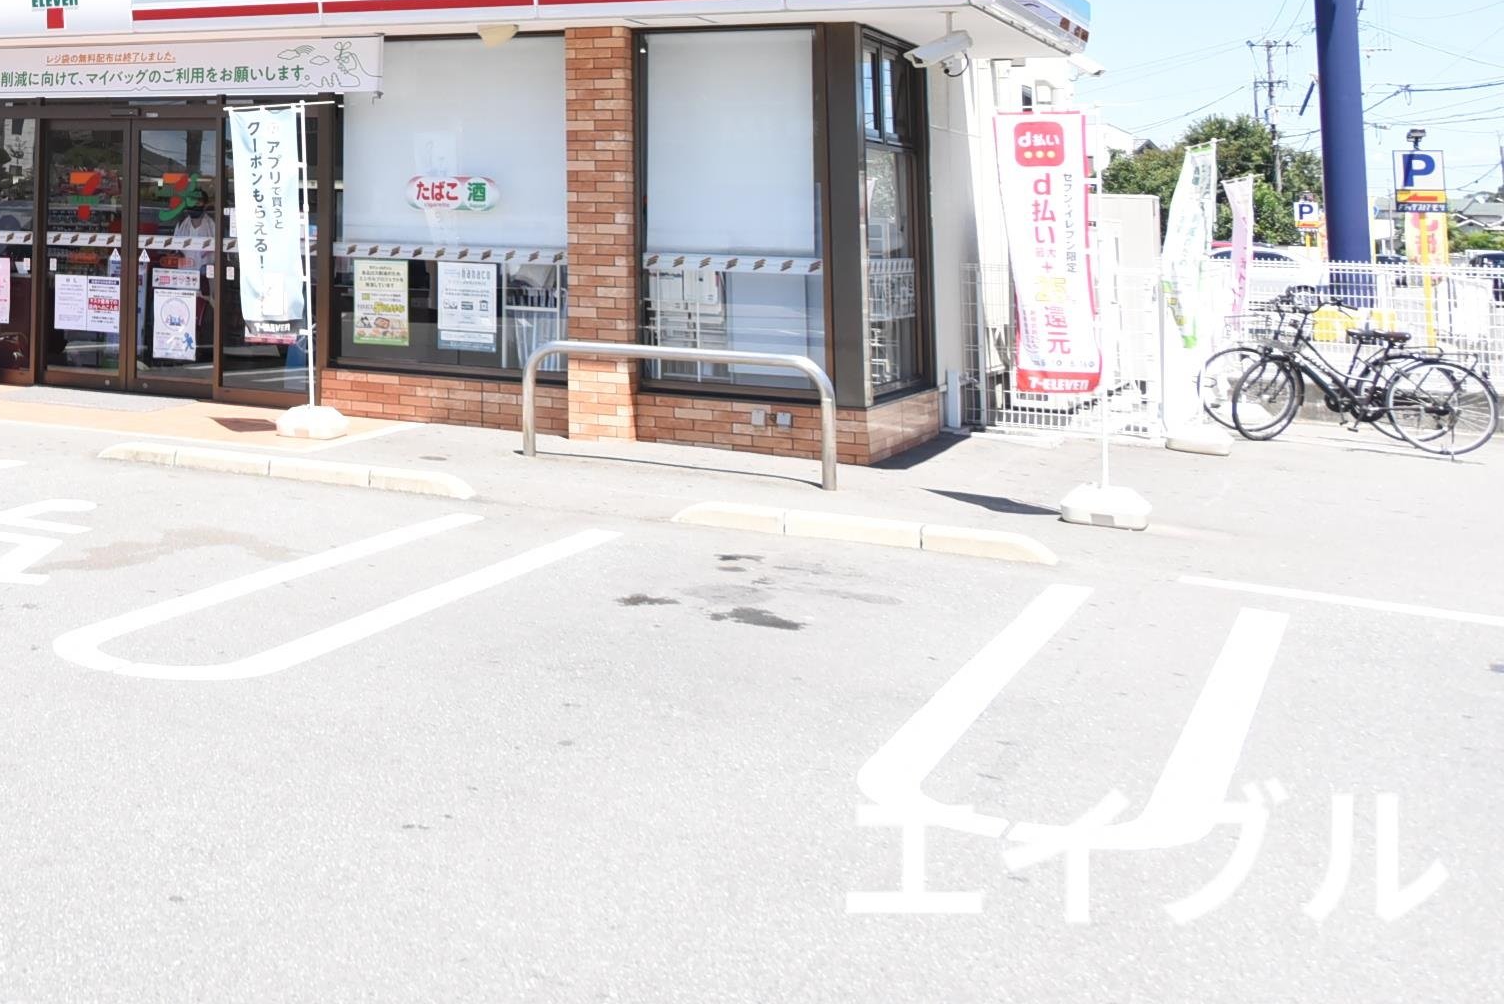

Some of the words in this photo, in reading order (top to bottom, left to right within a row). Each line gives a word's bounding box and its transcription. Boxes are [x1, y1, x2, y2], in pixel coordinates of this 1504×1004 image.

[46, 52, 176, 64] レジ袋の無料配布は終了しました。
[1017, 132, 1060, 147] d払い
[1402, 153, 1436, 187] P
[416, 181, 458, 201] たばこ
[467, 182, 486, 202] 酒
[1299, 204, 1313, 220] P
